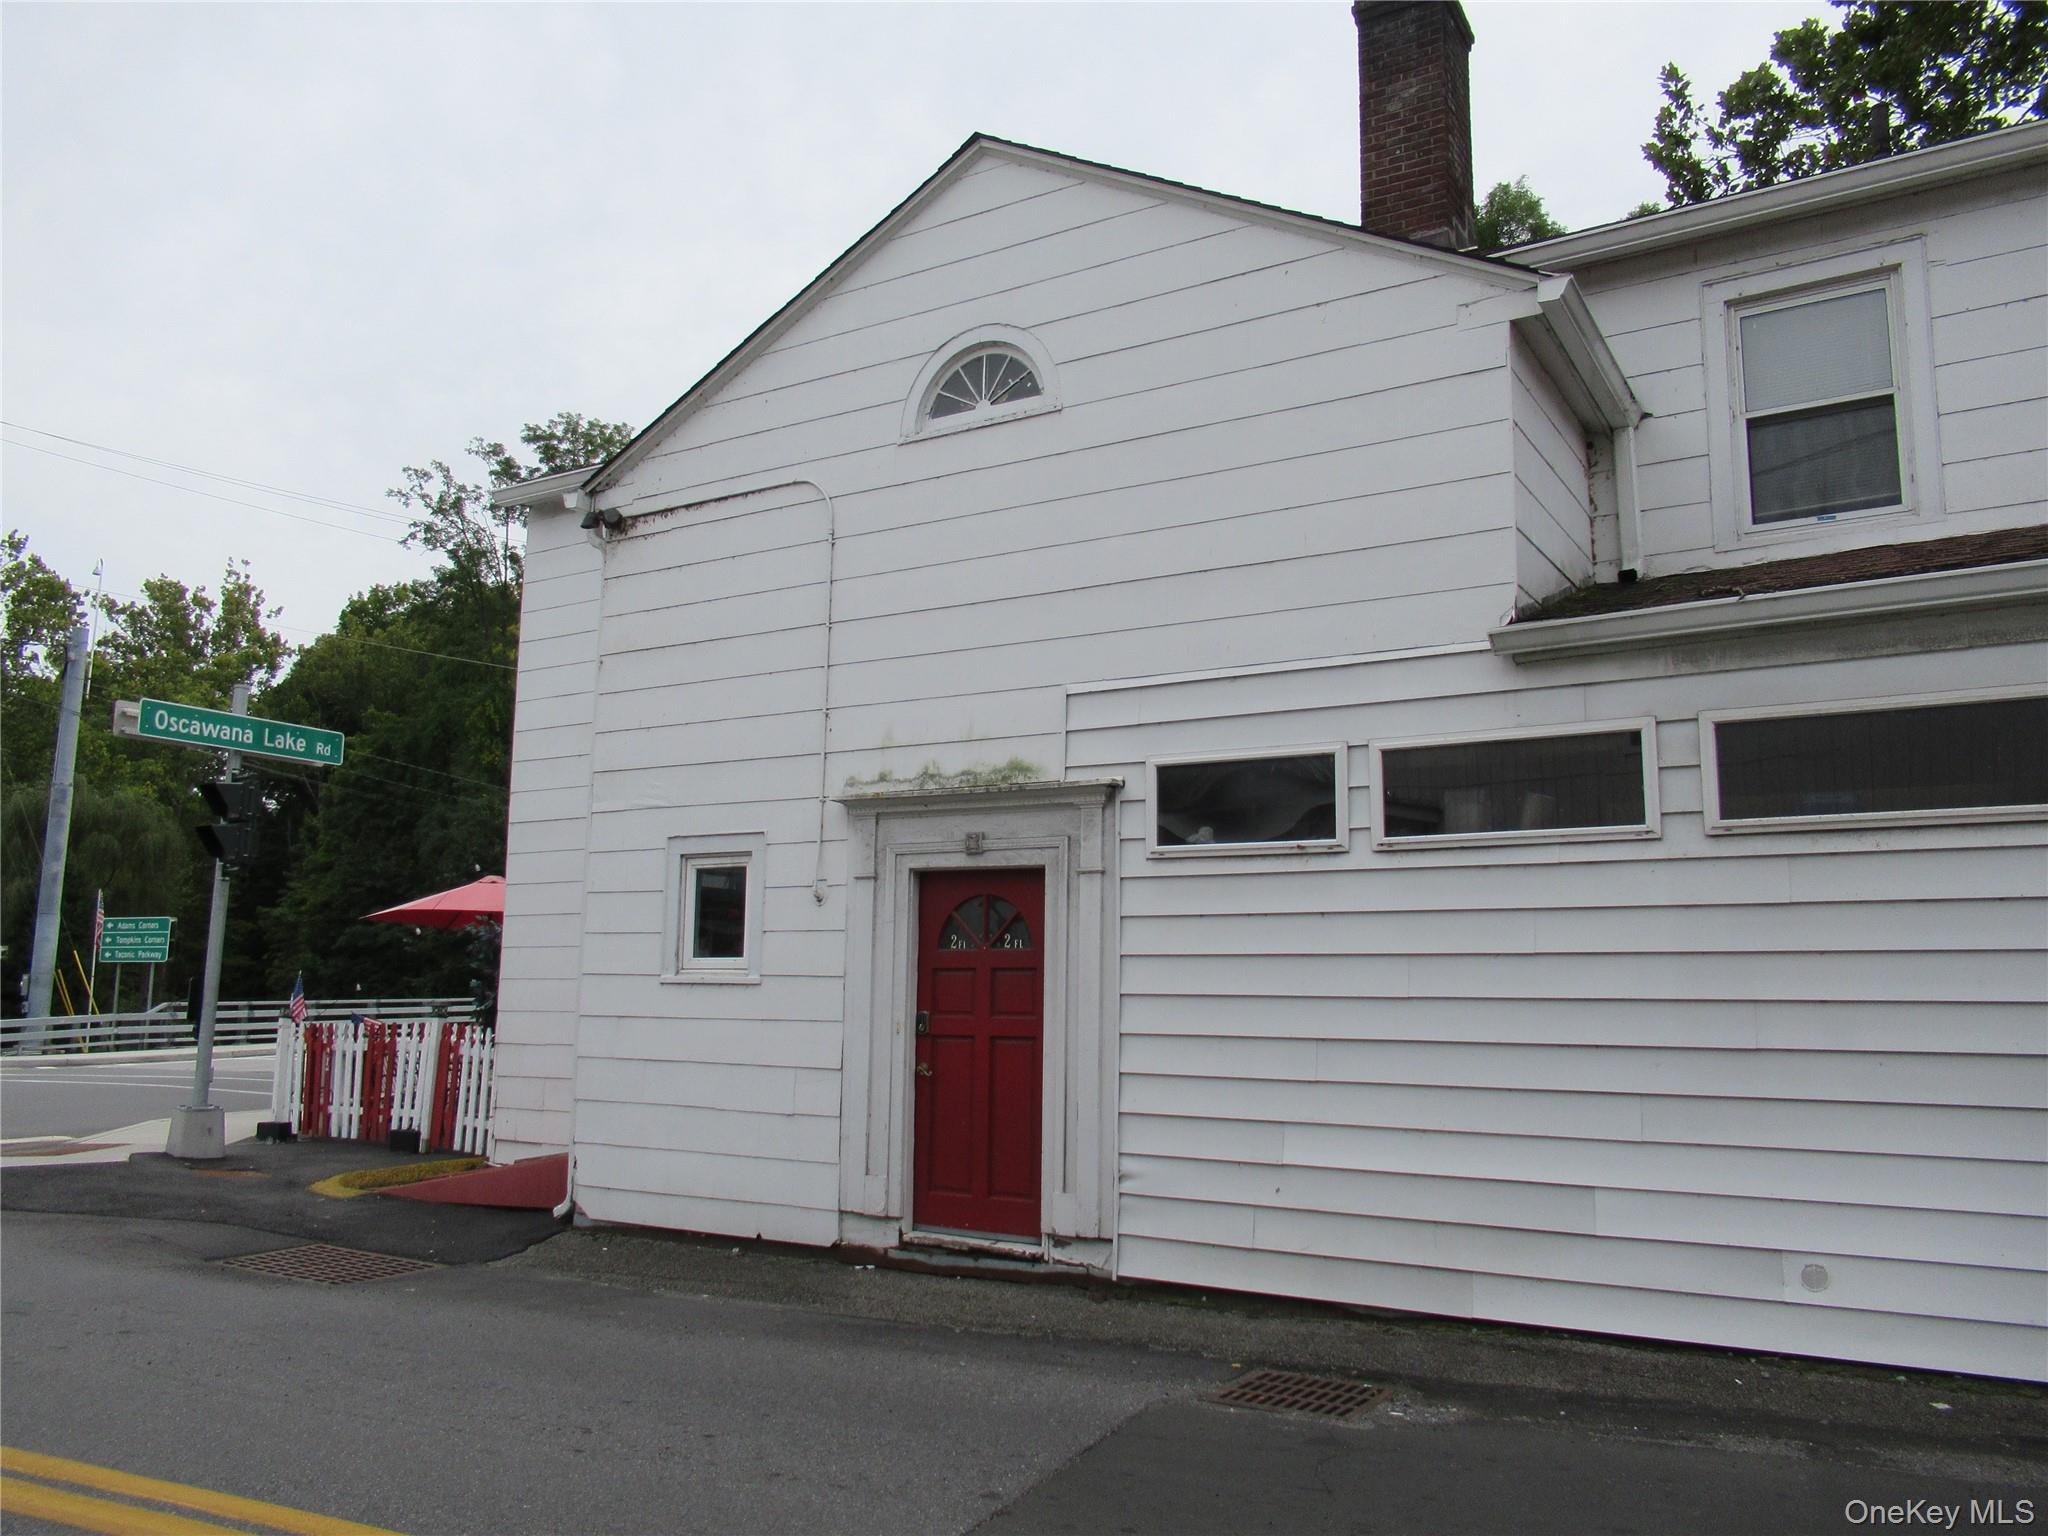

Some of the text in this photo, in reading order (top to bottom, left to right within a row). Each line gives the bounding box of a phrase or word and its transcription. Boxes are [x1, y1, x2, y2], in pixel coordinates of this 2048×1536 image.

[154, 709, 332, 757] Oscawana Lake Rd
[117, 921, 159, 929] Adams Corners
[116, 935, 165, 944] Tompkins Corners
[950, 934, 958, 949] 2
[1004, 933, 1011, 949] 2
[115, 950, 162, 959] Taconic Parkway
